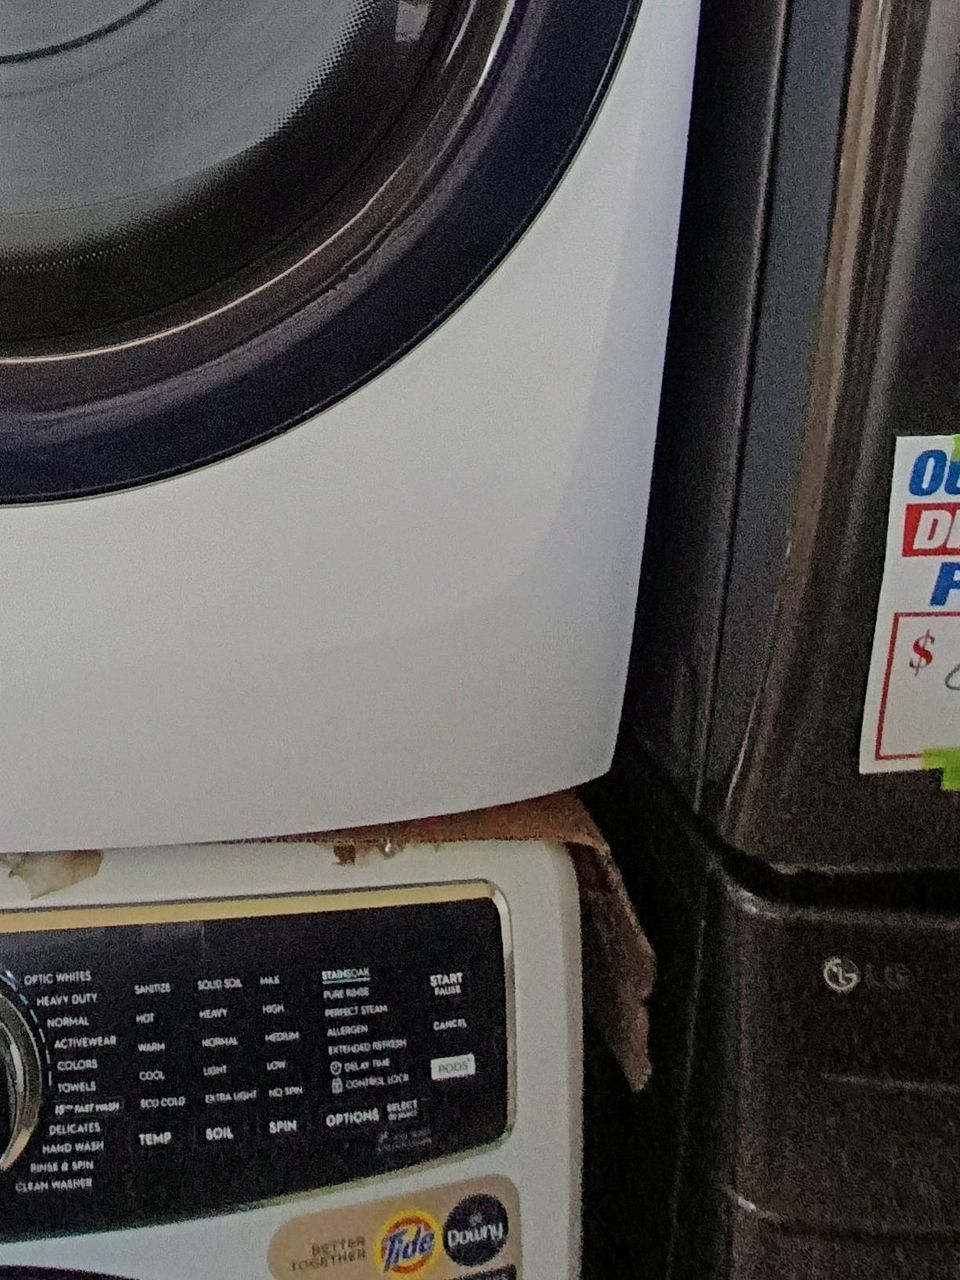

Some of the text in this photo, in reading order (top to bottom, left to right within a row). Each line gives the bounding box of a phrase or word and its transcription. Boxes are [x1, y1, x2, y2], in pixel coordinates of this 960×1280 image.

[24, 970, 92, 986] OPTIC WHITES
[430, 972, 463, 987] START
[134, 982, 171, 995] SANITIZE
[36, 993, 98, 1008] HEAVY DUTY
[199, 1007, 228, 1019] HEAVY
[262, 1003, 285, 1014] HIGH
[324, 1004, 388, 1018] PERFECT STEAM
[47, 1016, 90, 1028] NORMAL
[136, 1012, 155, 1024] HOT
[327, 1024, 368, 1037] ALLERGEN
[433, 1019, 467, 1031] CANCEL
[54, 1036, 117, 1050] ACTIVEWEAR
[202, 1036, 238, 1048] NORMAL
[265, 1031, 300, 1042] MEDIUM
[138, 1042, 165, 1052] WARM
[328, 1042, 371, 1056] EXTENDED
[57, 1059, 98, 1071] COLORS
[203, 1065, 227, 1076] LIGHT
[267, 1059, 286, 1071] LOW
[139, 1070, 165, 1081] COOL
[57, 1081, 97, 1093] TOWELS
[269, 1086, 303, 1098] NO SPIN
[140, 1096, 186, 1108] ECO COLD
[205, 1089, 257, 1104] EXTRA LIGHT
[326, 1108, 380, 1128] OPTIONS
[49, 1122, 101, 1136] DELICATES
[206, 1126, 234, 1141] SOIL
[269, 1120, 297, 1134] SPIN
[139, 1131, 172, 1146] TEMP
[42, 1141, 104, 1155] HAND WASH
[30, 1162, 58, 1173] RINSE
[71, 1160, 94, 1170] SPIN
[15, 1181, 48, 1193] CLEAN
[447, 1222, 504, 1247] Downy
[311, 1235, 366, 1258] BETTER
[382, 1224, 436, 1272] Tide
[290, 1249, 367, 1272] TOGETHER
